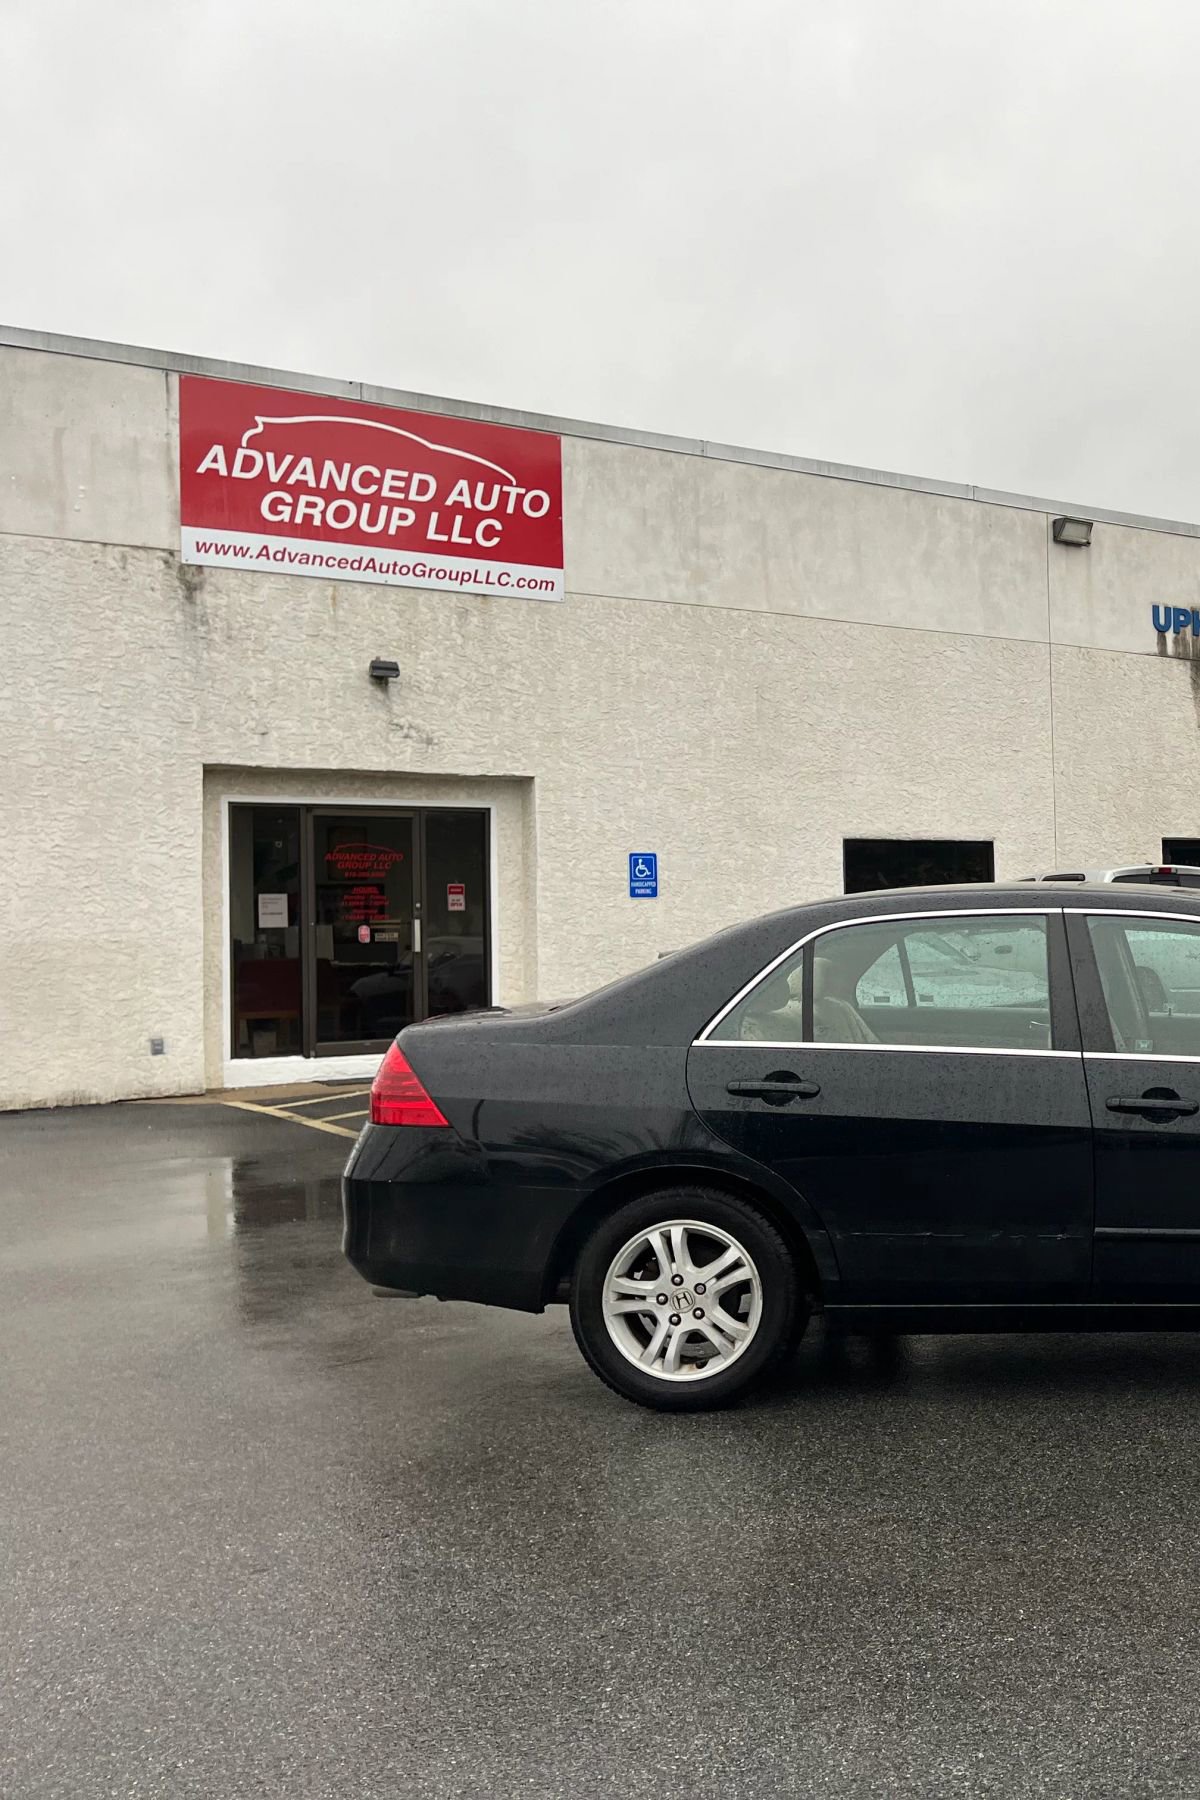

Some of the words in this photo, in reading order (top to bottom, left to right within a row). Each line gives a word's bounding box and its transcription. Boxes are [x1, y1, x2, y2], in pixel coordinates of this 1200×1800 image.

[196, 444, 437, 503] ADVANCED
[445, 479, 550, 518] AUTO
[260, 491, 416, 536] GROUP
[426, 511, 503, 548] LLC
[195, 540, 555, 592] www.AdvancedAutoGroupLLC.com
[325, 853, 376, 861] ADVANCED
[378, 853, 403, 861] AUTO
[337, 862, 370, 870] GROUP
